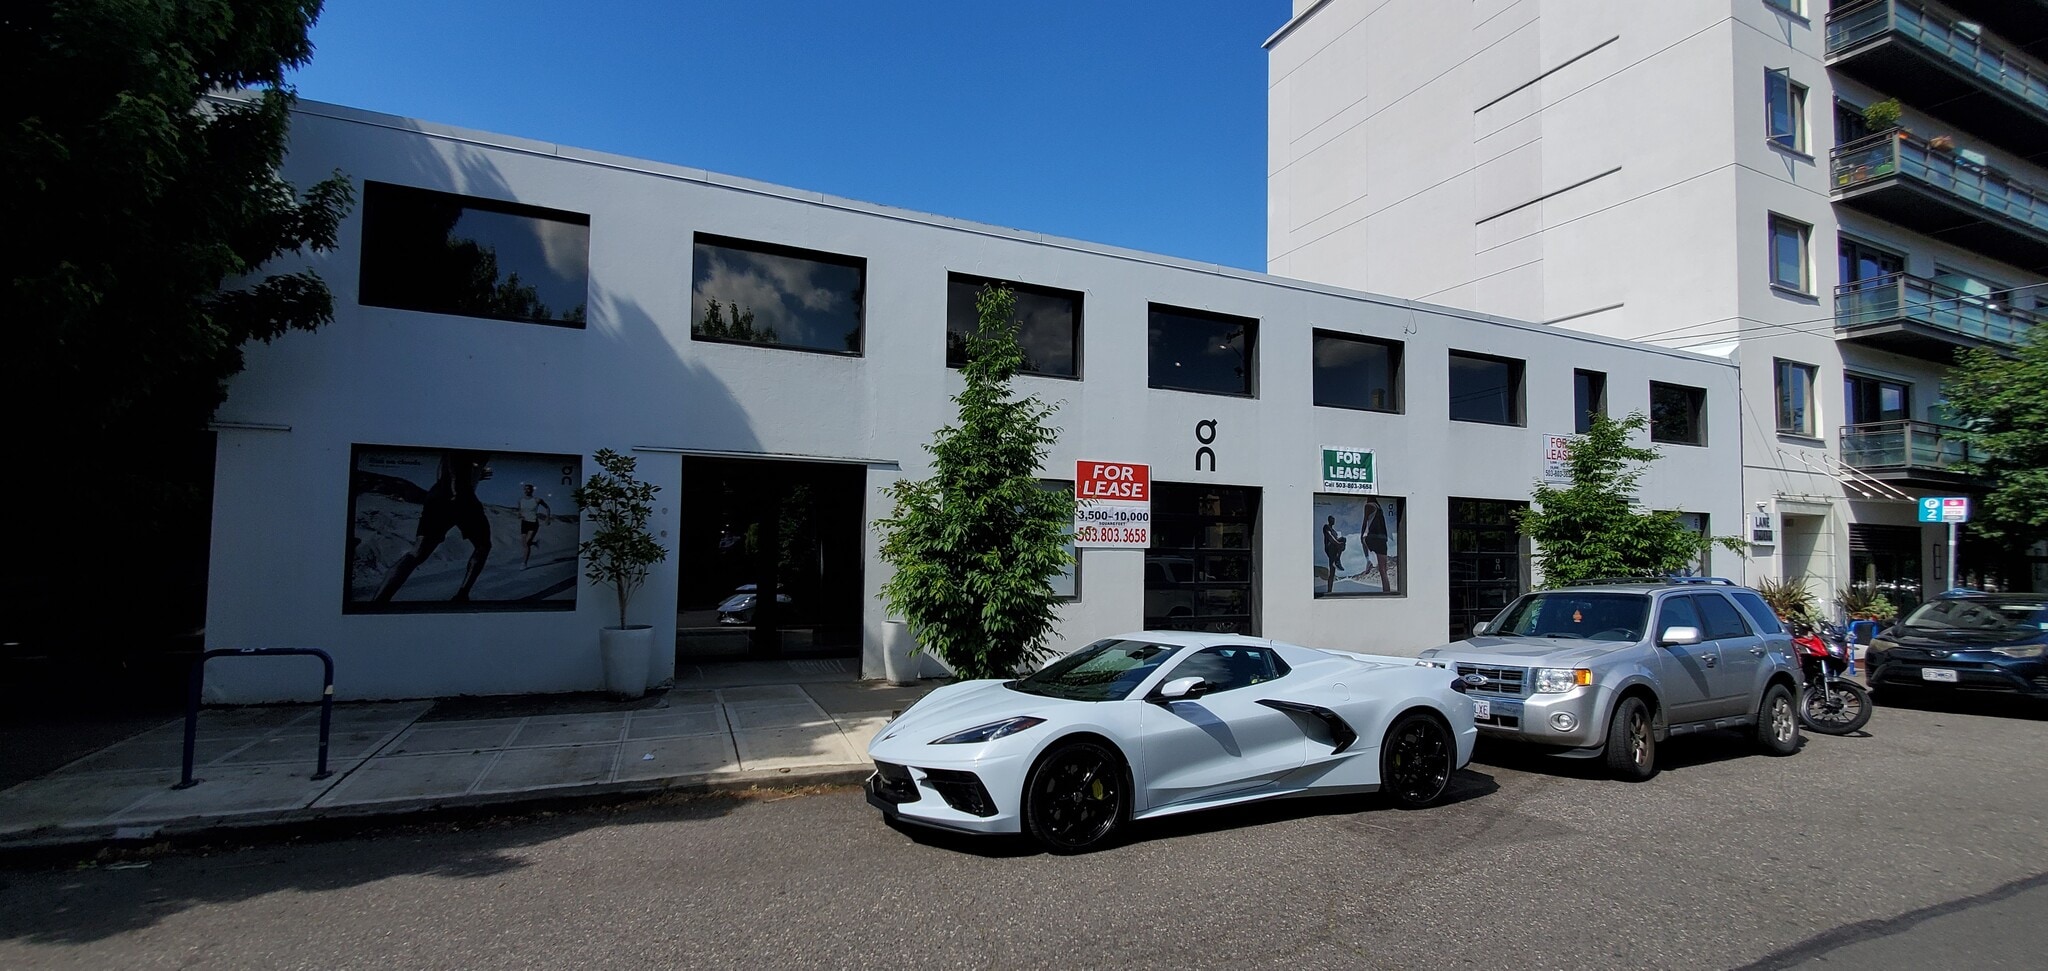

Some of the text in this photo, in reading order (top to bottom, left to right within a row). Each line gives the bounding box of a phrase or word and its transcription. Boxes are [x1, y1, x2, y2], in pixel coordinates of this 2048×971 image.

[1336, 451, 1361, 465] FOR
[1092, 464, 1134, 481] FOR
[1329, 465, 1367, 480] LEASE
[1083, 480, 1143, 498] LEASE
[1926, 509, 1937, 518] 2
[1755, 516, 1770, 528] LANE
[1078, 526, 1147, 544] 503.803.3658
